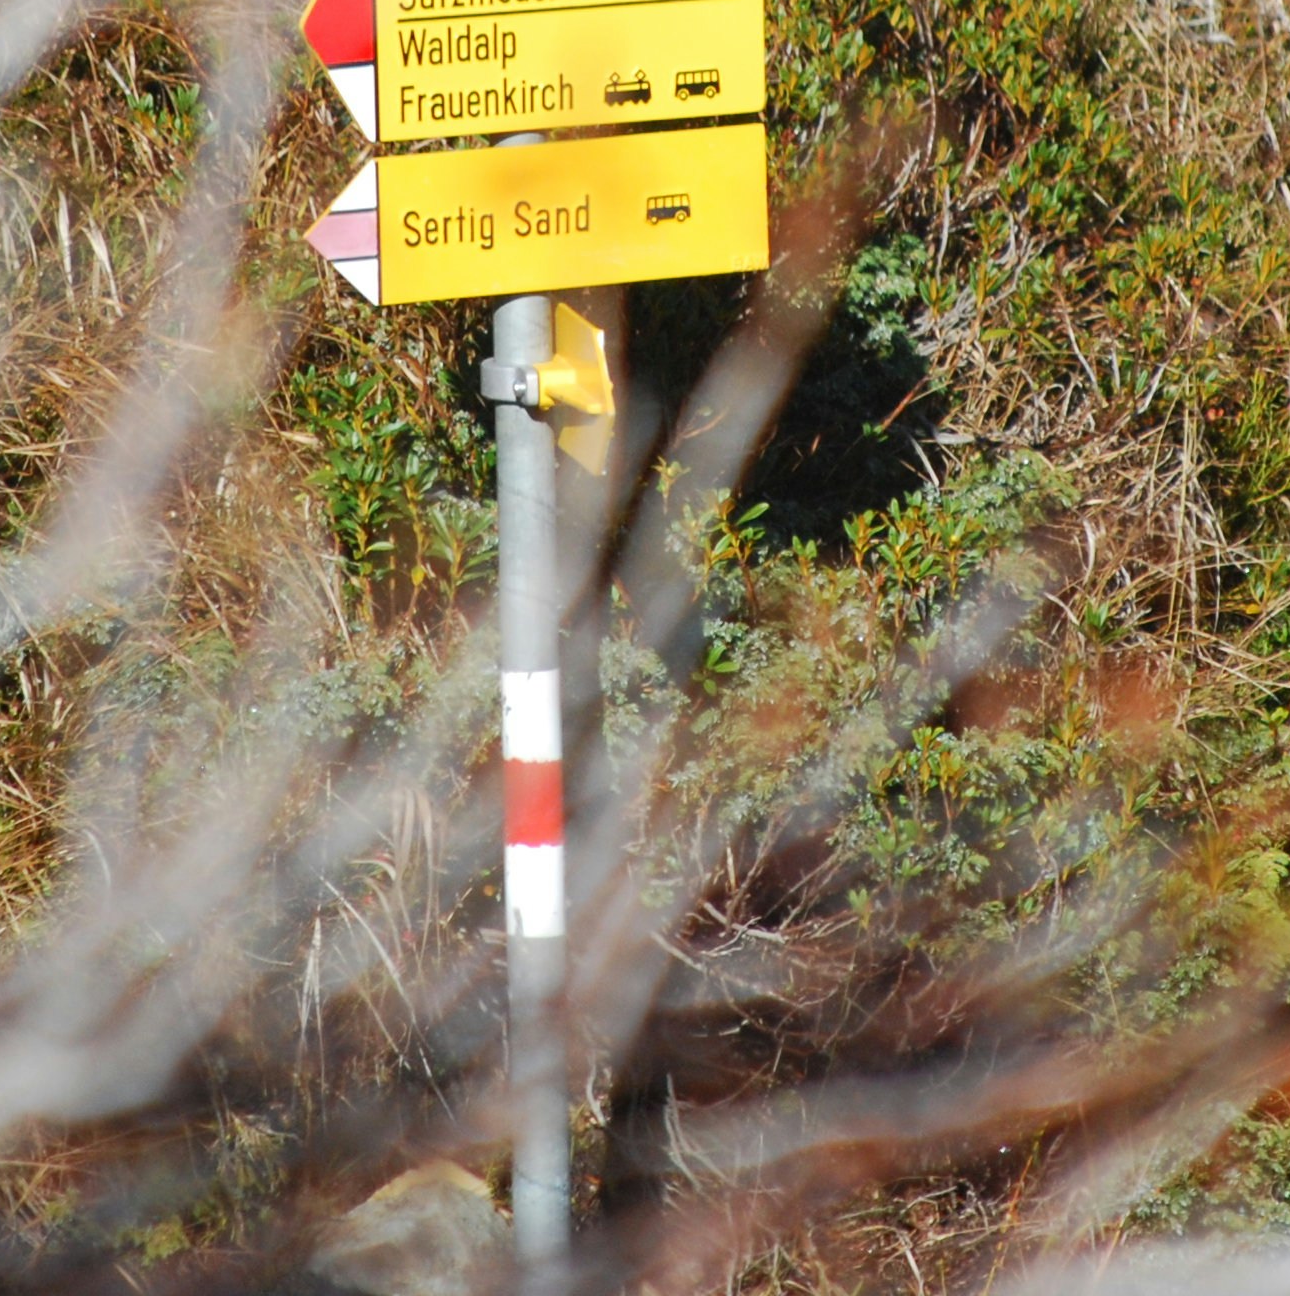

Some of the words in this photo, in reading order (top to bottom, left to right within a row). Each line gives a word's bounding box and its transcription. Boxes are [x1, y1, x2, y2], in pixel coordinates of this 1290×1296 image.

[399, 23, 517, 69] Waldalp
[400, 73, 574, 123] Frauenkirch
[403, 205, 495, 250] Sertig
[514, 194, 590, 237] Sand
